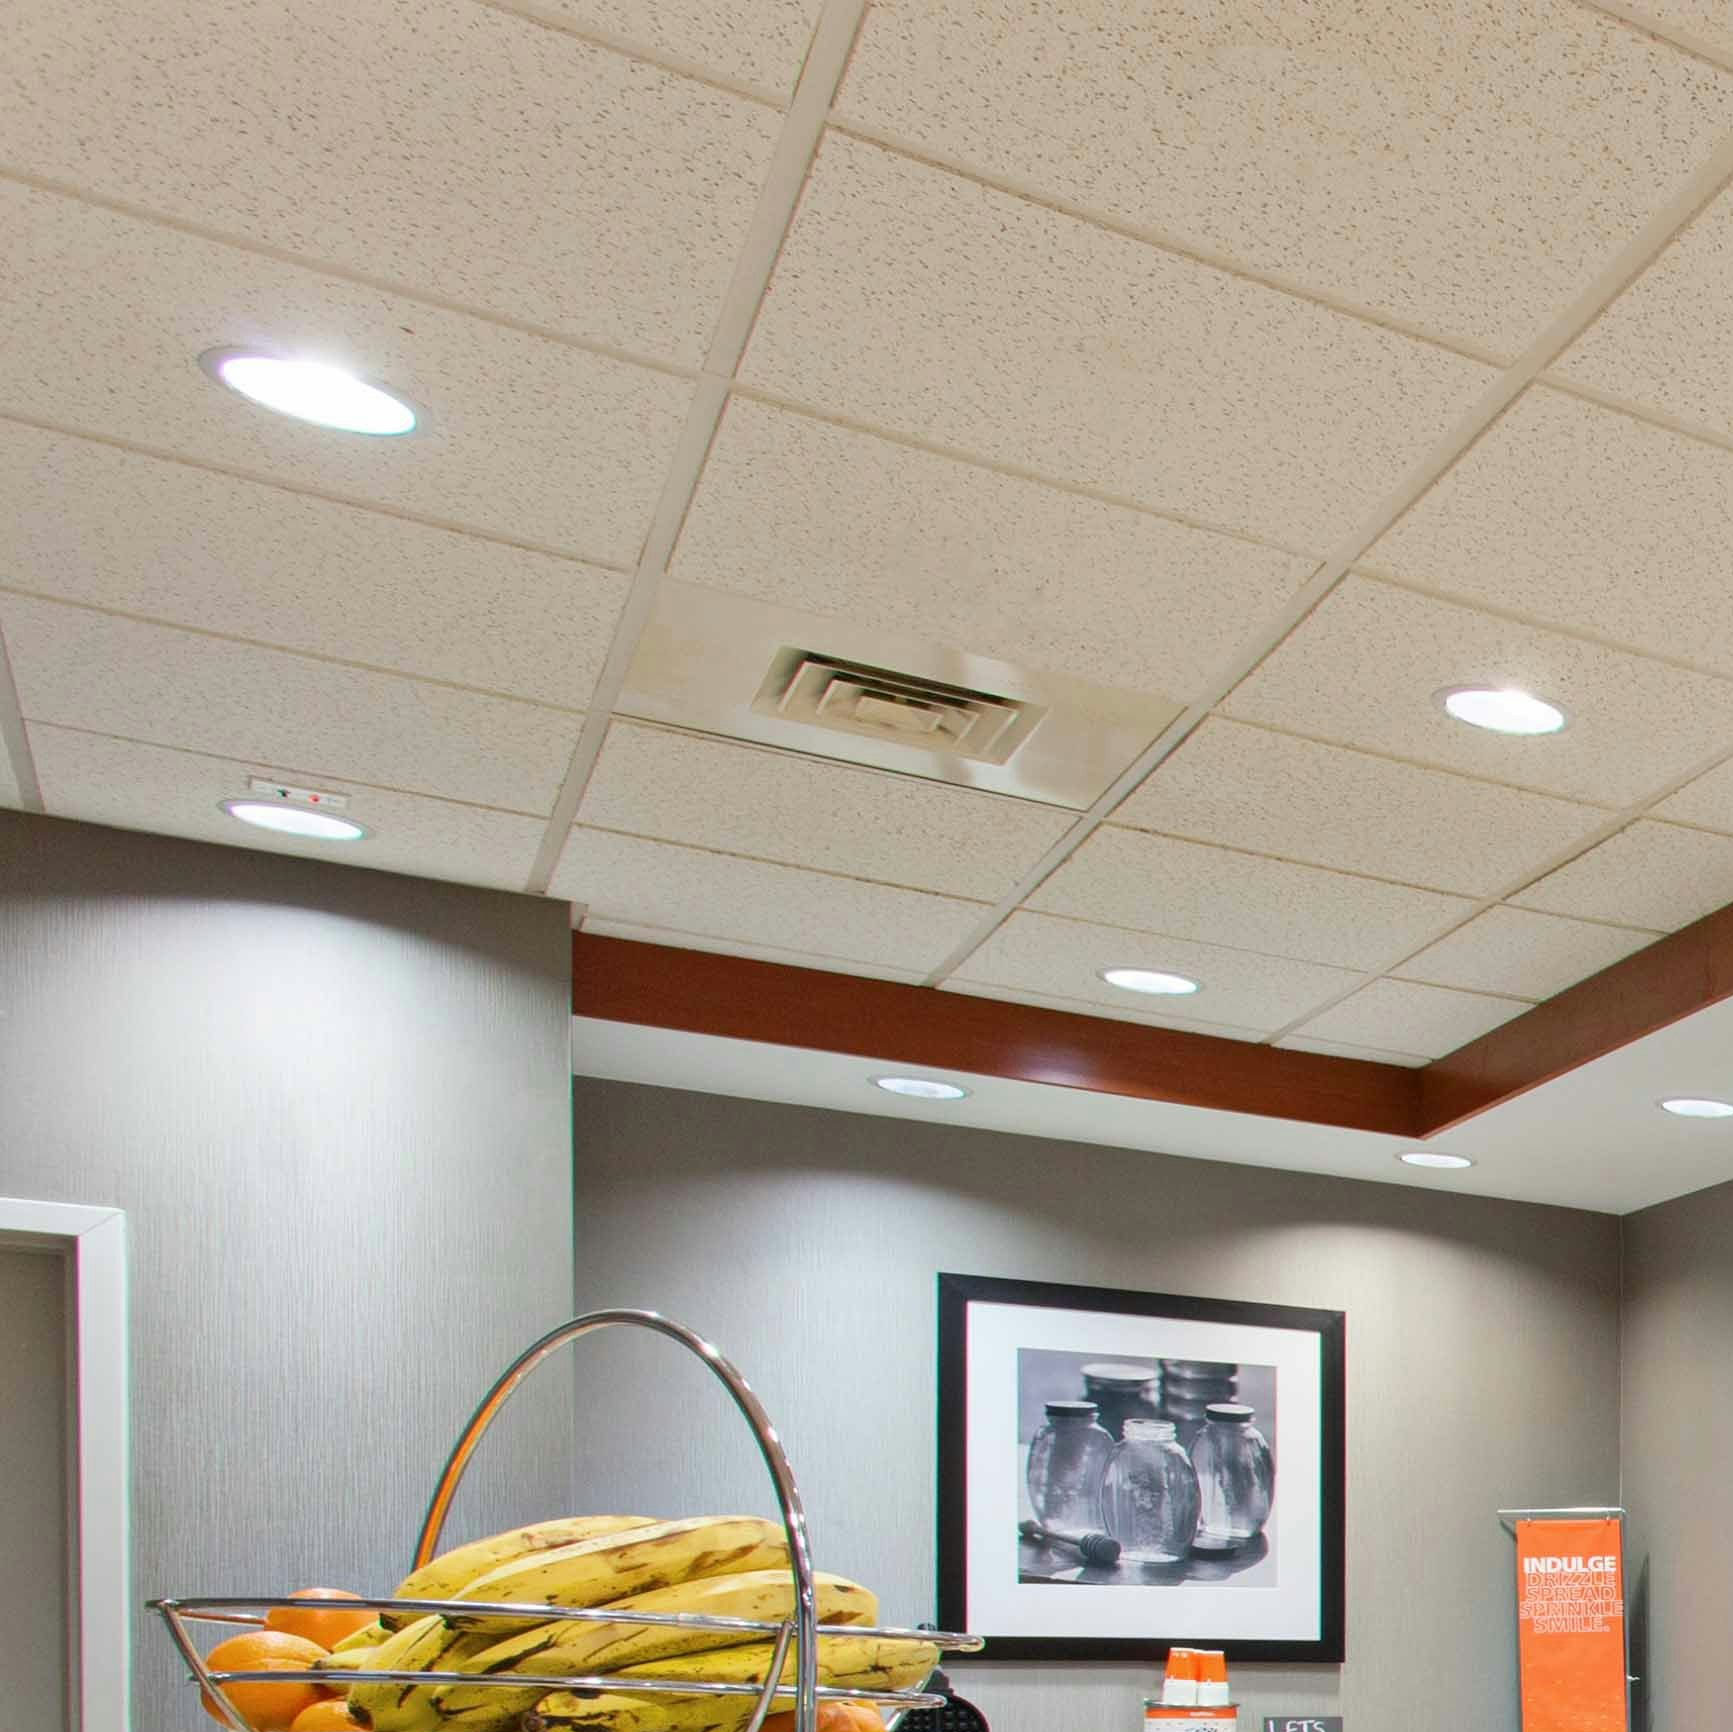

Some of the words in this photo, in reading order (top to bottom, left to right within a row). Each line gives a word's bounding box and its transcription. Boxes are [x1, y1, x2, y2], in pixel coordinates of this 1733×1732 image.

[1523, 1556, 1616, 1573] INDULGE
[1526, 1572, 1616, 1587] DRIZZLE
[1526, 1585, 1616, 1602] SPREAD
[1519, 1600, 1624, 1618] SPRINKLE
[1532, 1615, 1610, 1633] SMILE.
